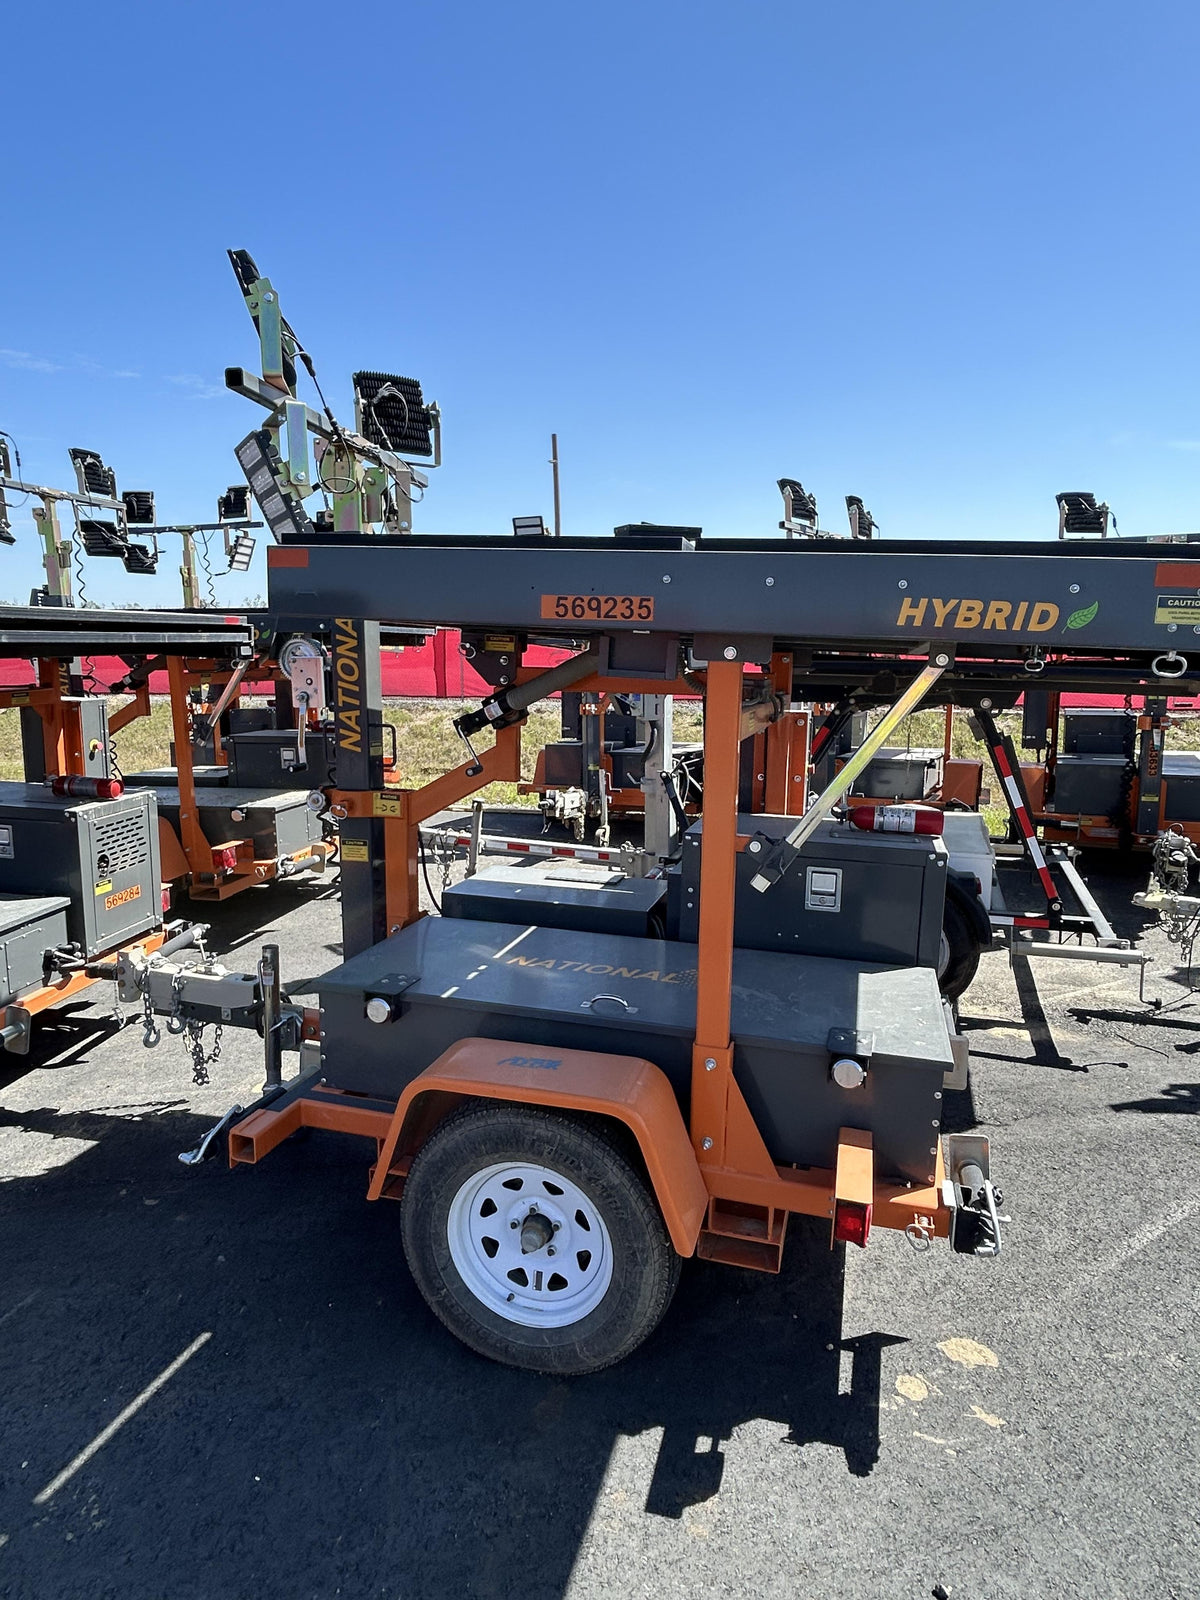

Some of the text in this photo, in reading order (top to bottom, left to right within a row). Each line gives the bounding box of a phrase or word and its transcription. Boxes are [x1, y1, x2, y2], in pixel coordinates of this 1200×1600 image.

[554, 596, 652, 620] 569235
[896, 597, 1060, 632] HYBRID
[106, 886, 140, 909] 569284
[506, 955, 680, 983] NATIONAL
